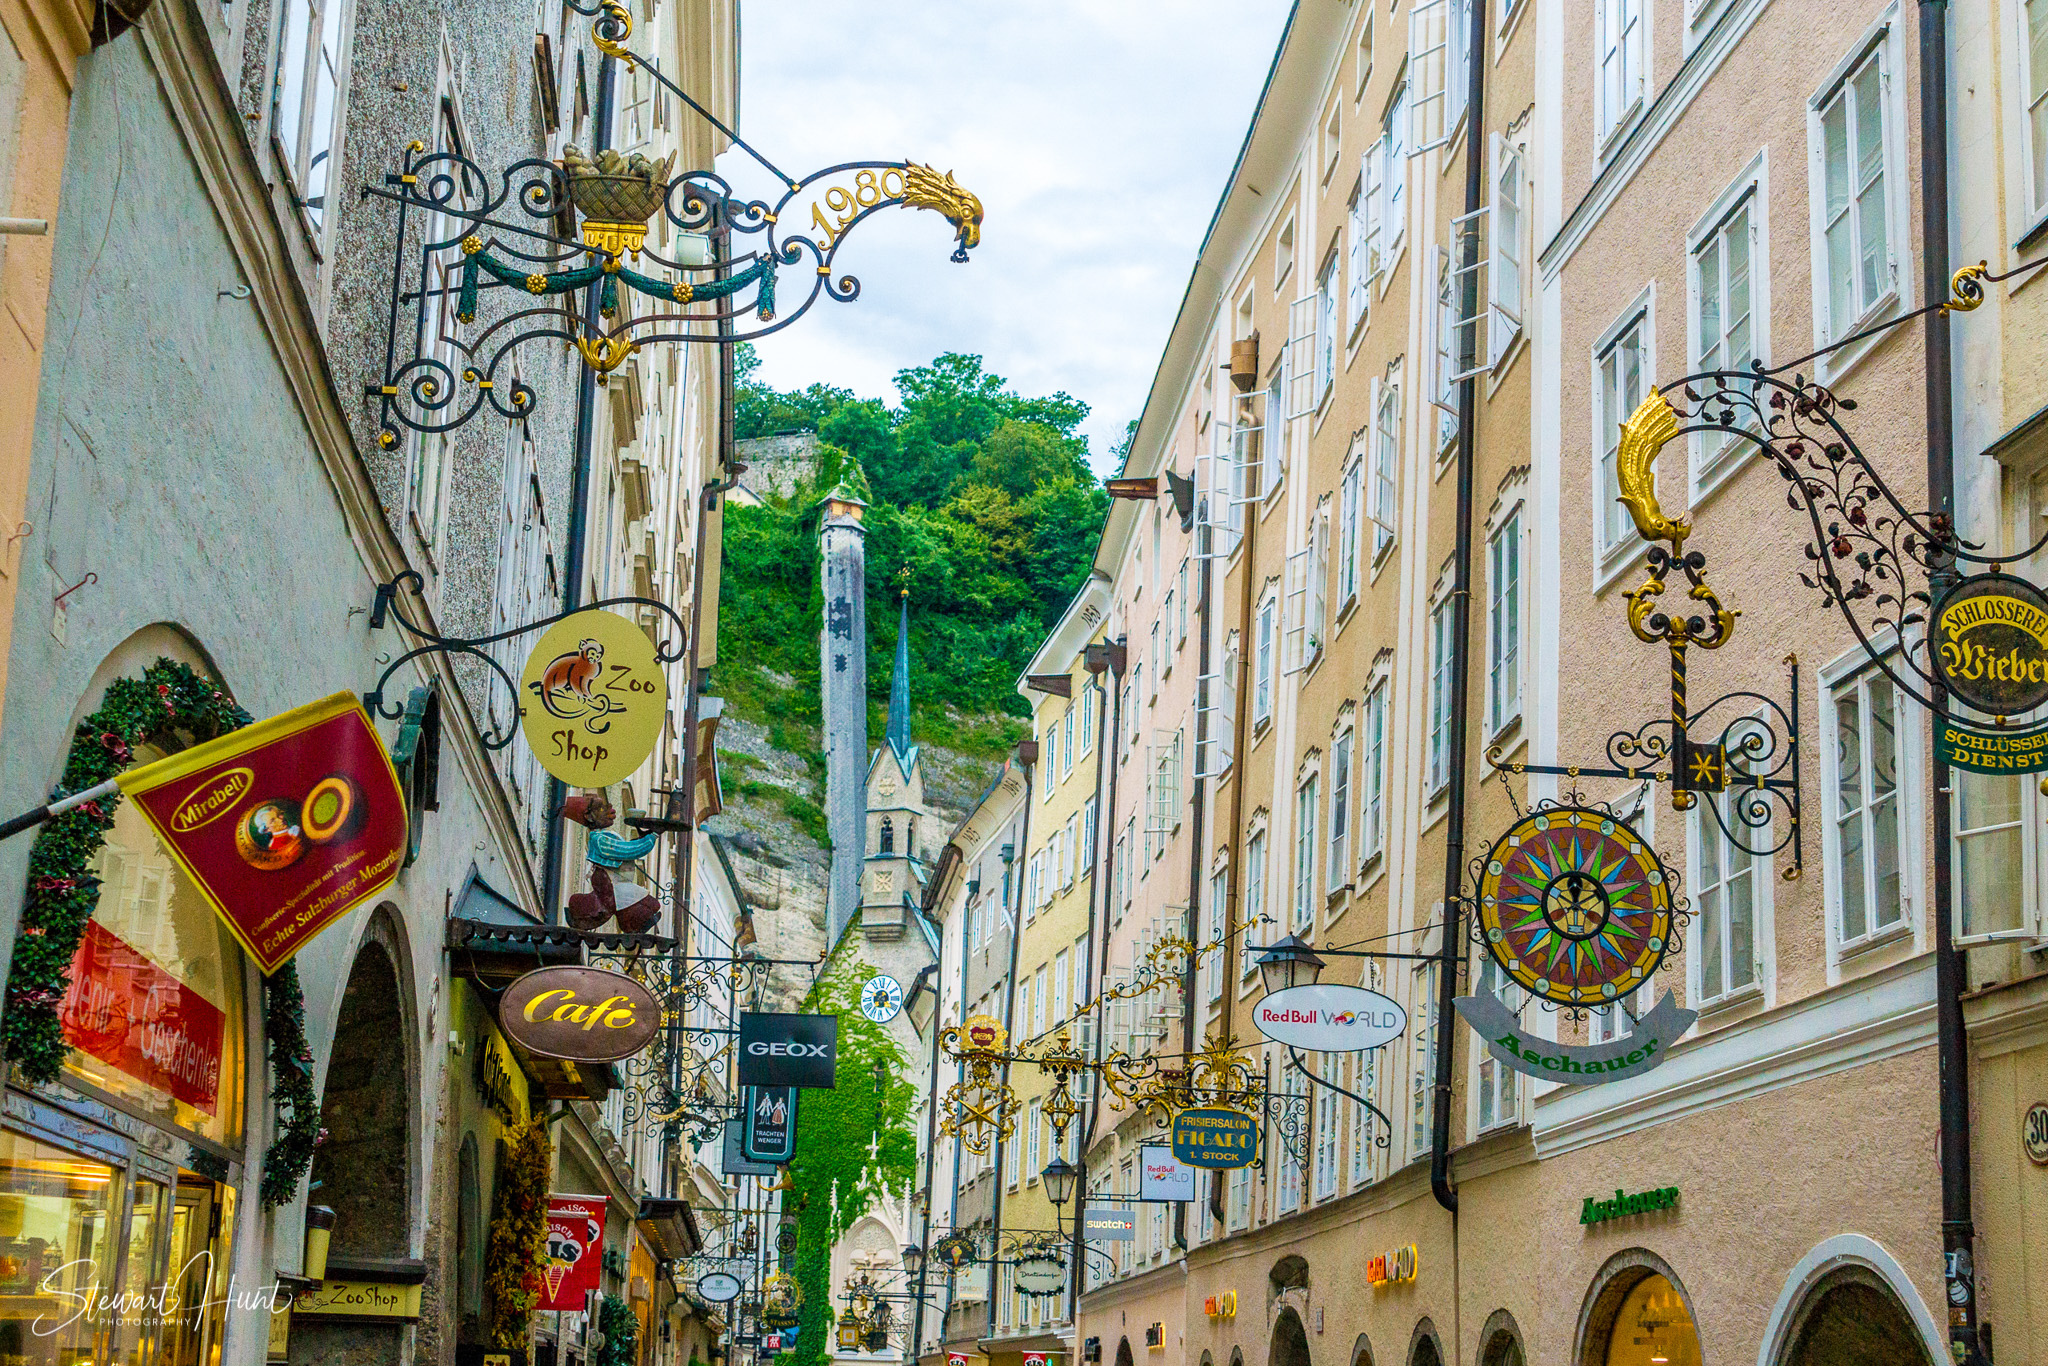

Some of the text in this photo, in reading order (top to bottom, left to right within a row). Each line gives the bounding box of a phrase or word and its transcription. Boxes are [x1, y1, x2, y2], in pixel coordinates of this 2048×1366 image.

[811, 167, 906, 251] 1980
[605, 664, 656, 694] Zoo
[551, 729, 609, 772] Shop
[1952, 747, 2044, 768] DIENST
[178, 773, 246, 829] Mirabell
[262, 922, 297, 956] Echte
[295, 875, 358, 930] Salzburger
[523, 989, 636, 1031] Café
[1262, 1008, 1396, 1028] Red Bull WORLD
[747, 1041, 828, 1058] GEOX
[1494, 1032, 1659, 1075] Aschauer
[755, 1130, 785, 1138] TRACHTEN
[1180, 1116, 1250, 1130] FRISIERSALON
[1176, 1130, 1253, 1149] FIGARO
[1190, 1151, 1239, 1161] 1. STOCK
[1147, 1164, 1161, 1172] Red
[1579, 1186, 1679, 1225] Aschauer
[1086, 1219, 1125, 1229] swatch
[548, 1240, 580, 1263] IS
